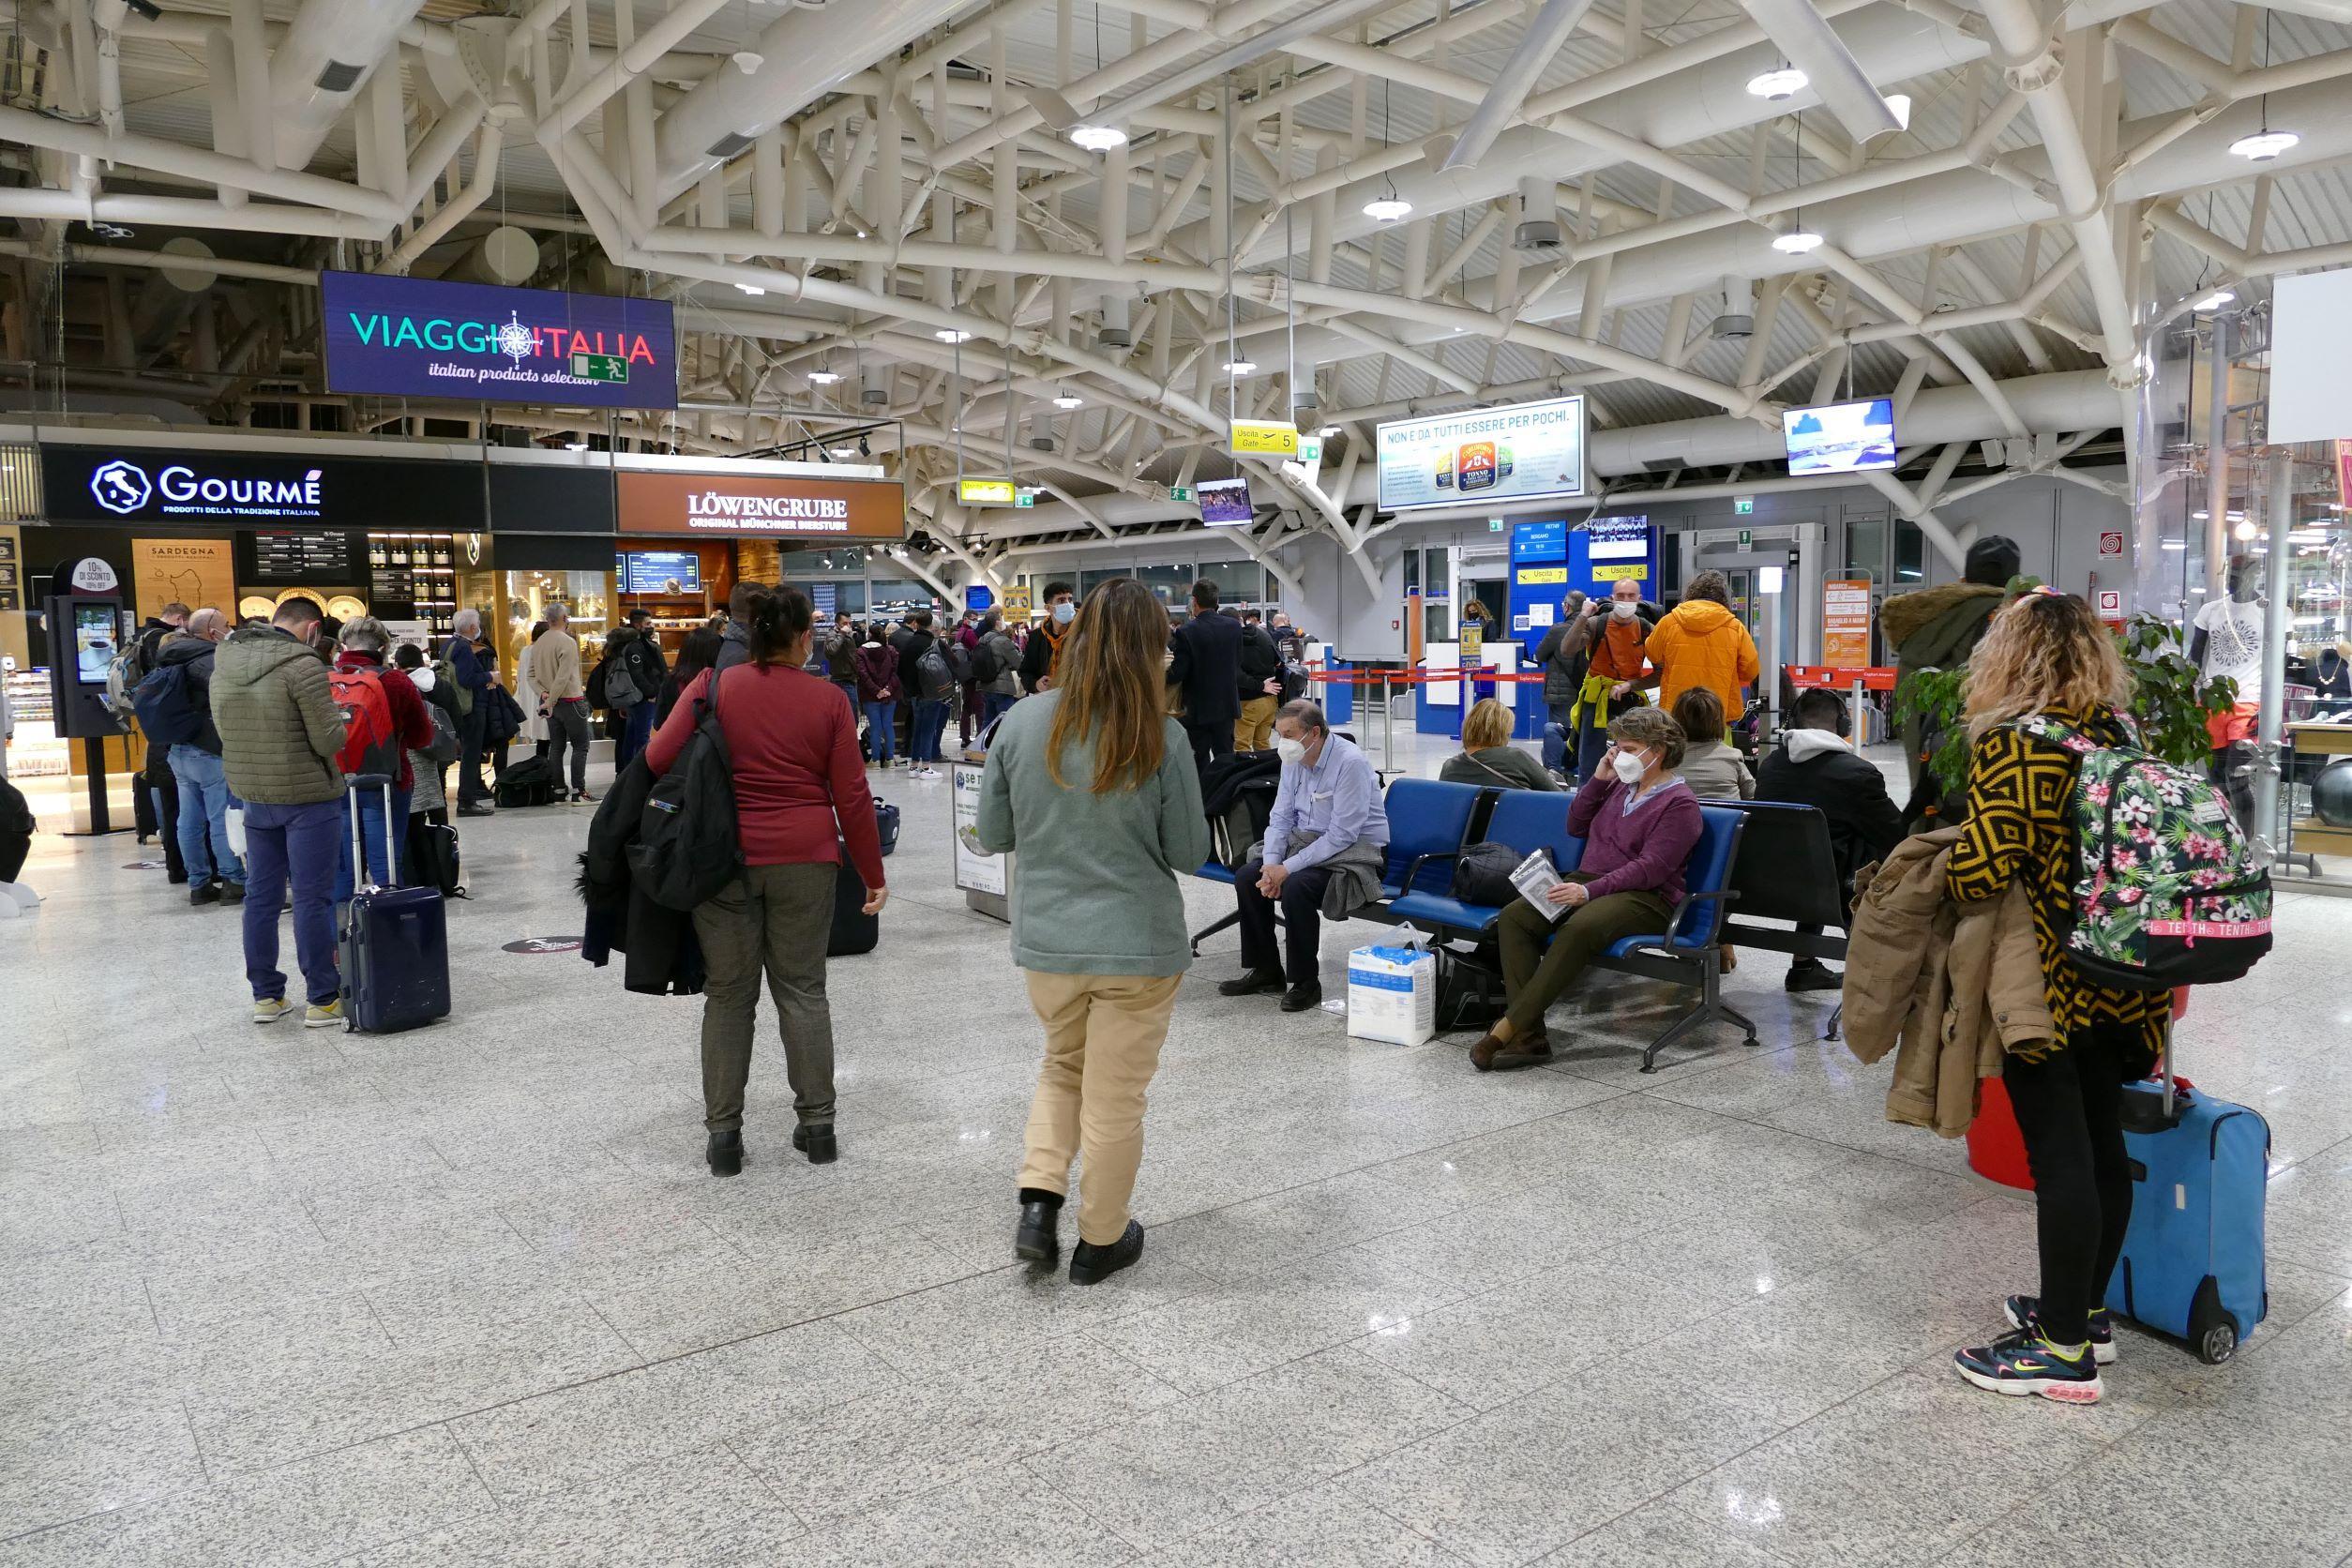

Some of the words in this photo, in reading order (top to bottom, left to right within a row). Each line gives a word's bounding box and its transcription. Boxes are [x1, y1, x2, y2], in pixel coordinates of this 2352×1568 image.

[429, 363, 476, 377] italian
[478, 367, 538, 383] products
[1388, 432, 1407, 445] NON
[1418, 429, 1431, 441] DA
[1434, 424, 1463, 439] TUTTI
[1465, 418, 1506, 434] ESSERE
[1508, 414, 1530, 428] PER
[1533, 410, 1570, 426] POCHI.
[1243, 439, 1259, 447] Gate
[1283, 435, 1290, 447] 5
[163, 505, 204, 514] PRODOTTI
[234, 507, 280, 516] TRADIZIONE
[687, 491, 848, 519] LÖWENGRUBE
[689, 517, 739, 529] ORIGINAL
[151, 547, 215, 555] SARDEGNA
[87, 573, 111, 581] SCONTO
[1534, 569, 1553, 578] Uscita
[1559, 571, 1563, 580] 7
[1637, 567, 1643, 577] 5
[2219, 924, 2251, 936] TENTH
